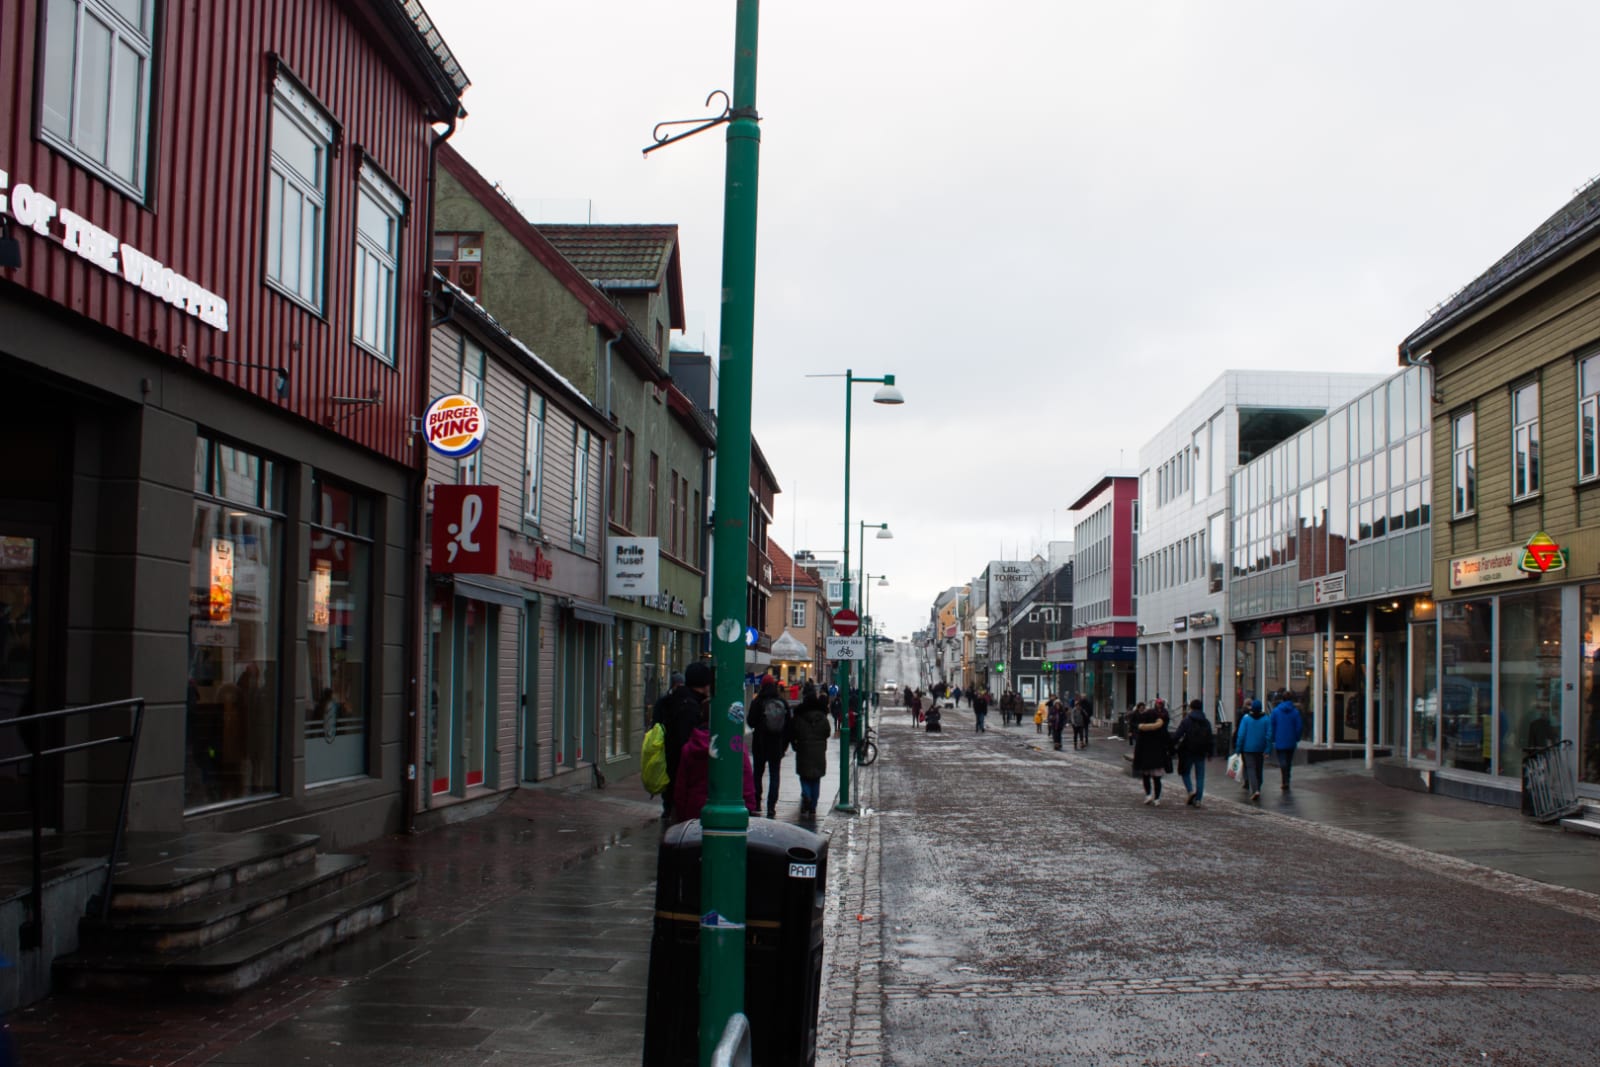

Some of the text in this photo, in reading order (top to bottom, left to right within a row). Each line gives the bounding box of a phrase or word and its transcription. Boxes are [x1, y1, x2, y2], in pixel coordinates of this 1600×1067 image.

[11, 183, 57, 236] OF
[59, 208, 118, 273] THE
[120, 243, 229, 332] WHOPPER
[429, 406, 478, 425] BURGER
[430, 417, 479, 441] KING
[616, 545, 644, 555] Brille
[993, 574, 1029, 582] TORGET
